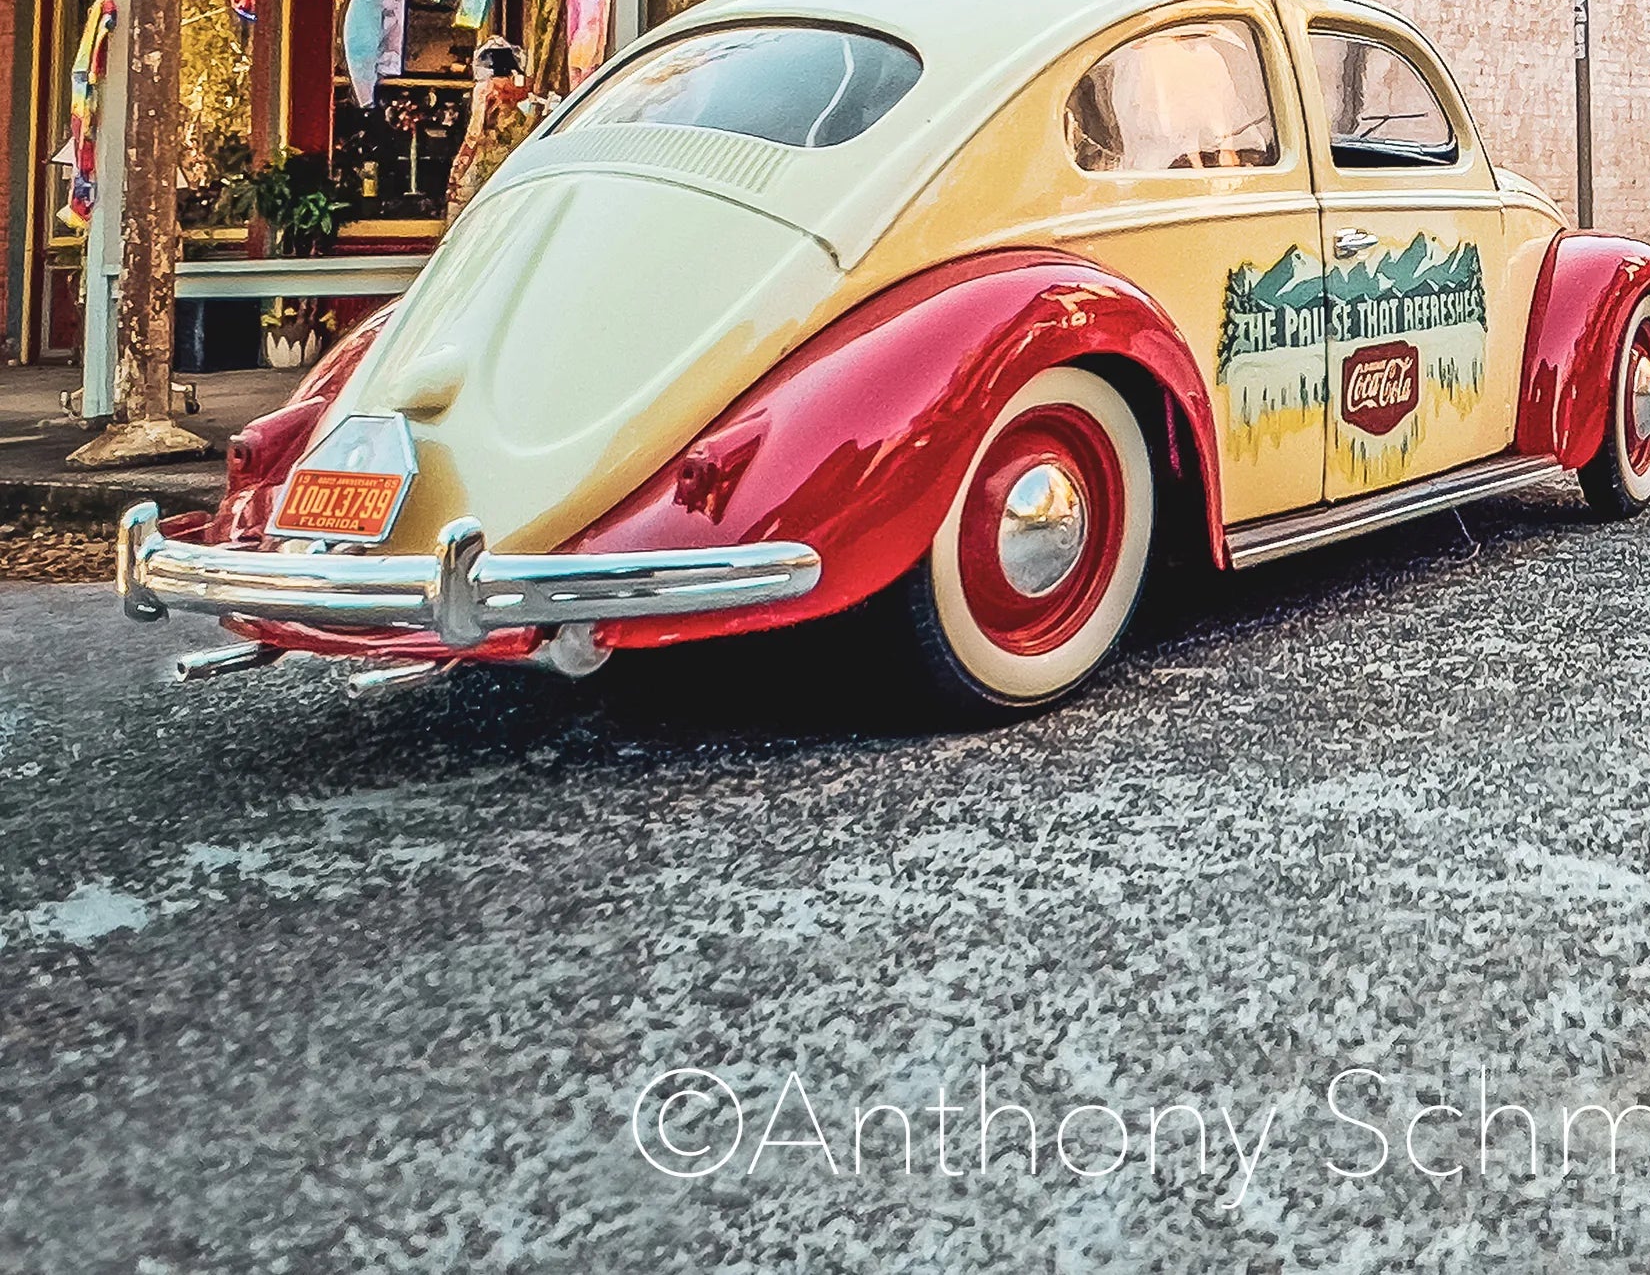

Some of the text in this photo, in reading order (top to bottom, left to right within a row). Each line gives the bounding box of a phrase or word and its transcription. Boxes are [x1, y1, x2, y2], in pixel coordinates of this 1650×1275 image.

[1236, 311, 1277, 351] THE
[1285, 302, 1352, 348] PAUSE
[1357, 298, 1402, 339] THAT
[300, 516, 360, 530] FLORIDA
